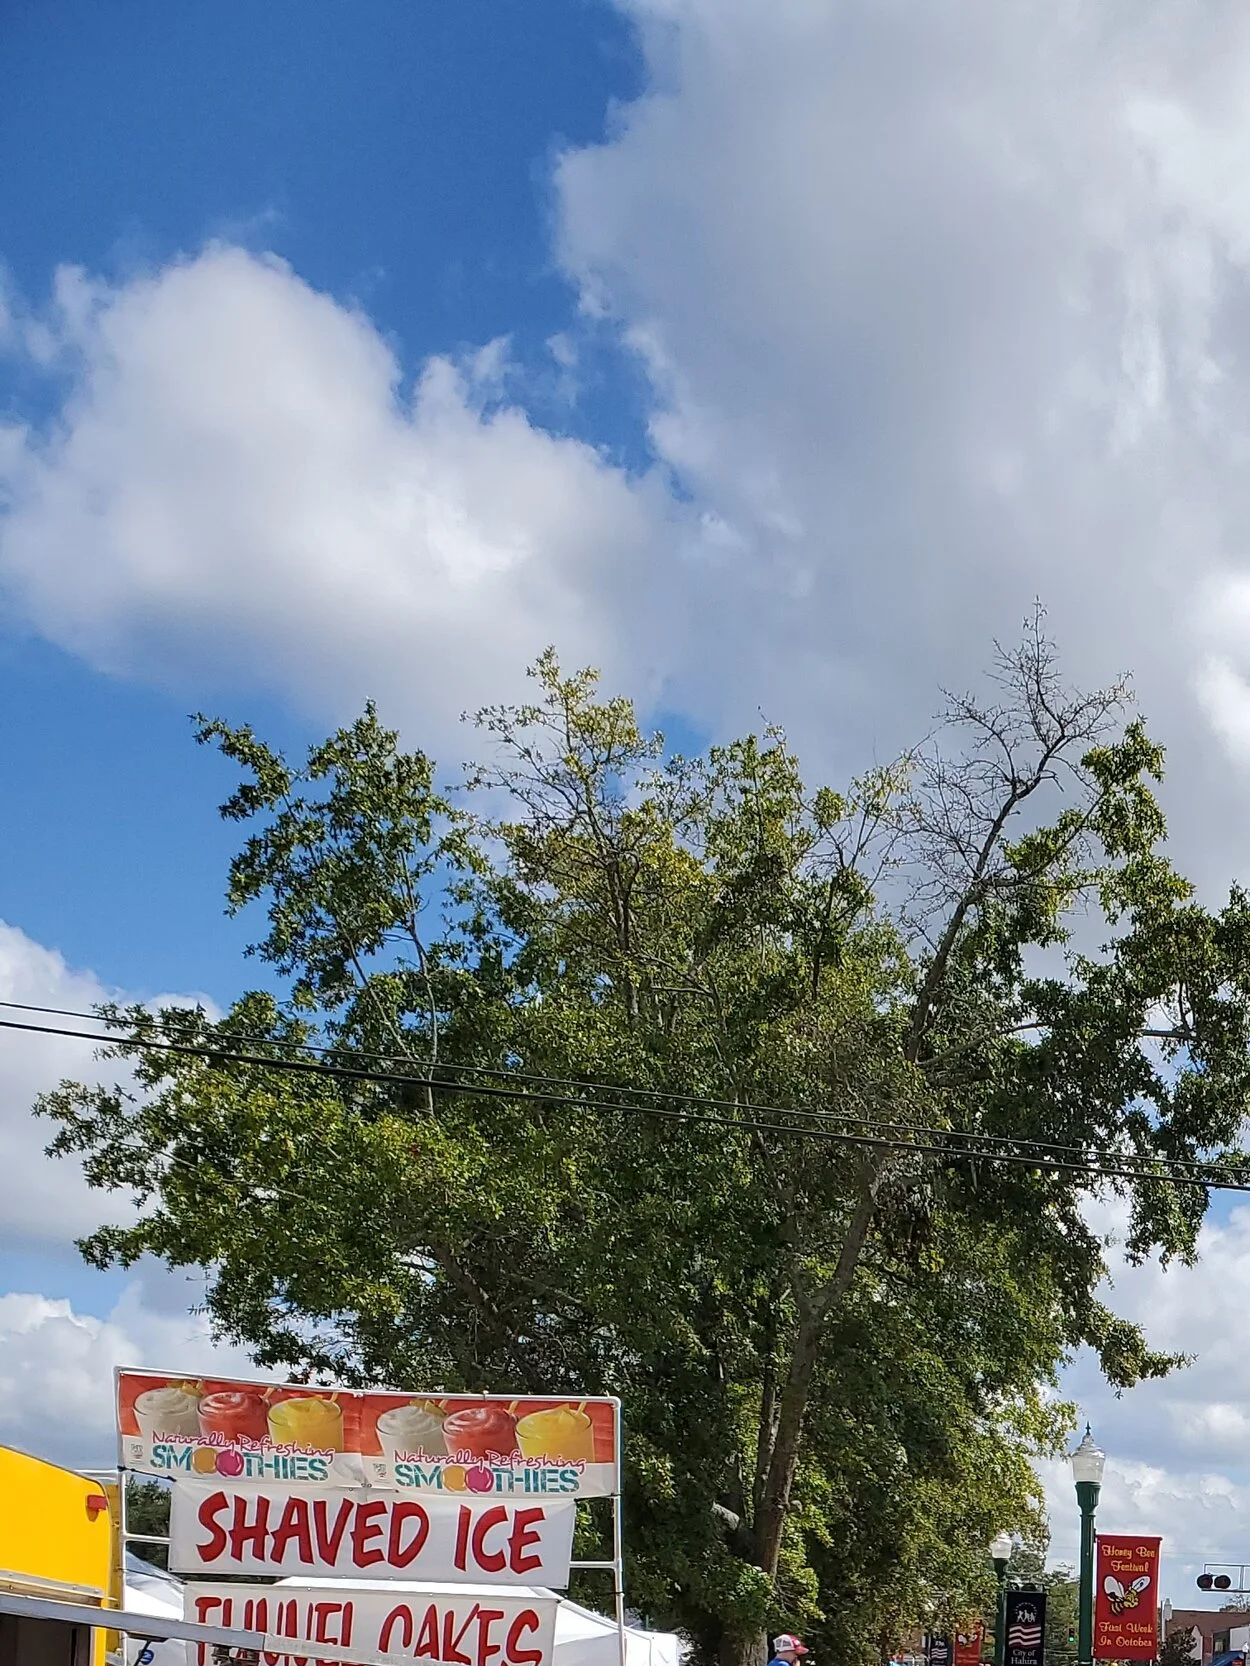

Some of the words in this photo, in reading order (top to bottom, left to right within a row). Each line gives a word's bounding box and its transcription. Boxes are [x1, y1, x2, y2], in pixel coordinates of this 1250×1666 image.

[152, 1430, 234, 1455] Naturally
[239, 1434, 335, 1464] Refreshing
[394, 1445, 484, 1472] Naturally
[488, 1450, 586, 1474] Refreshing
[196, 1491, 429, 1568] SHAVED
[455, 1505, 548, 1574] ICE
[1101, 1545, 1132, 1560] Honey
[1135, 1546, 1155, 1558] Bee
[1111, 1560, 1149, 1572] Festival
